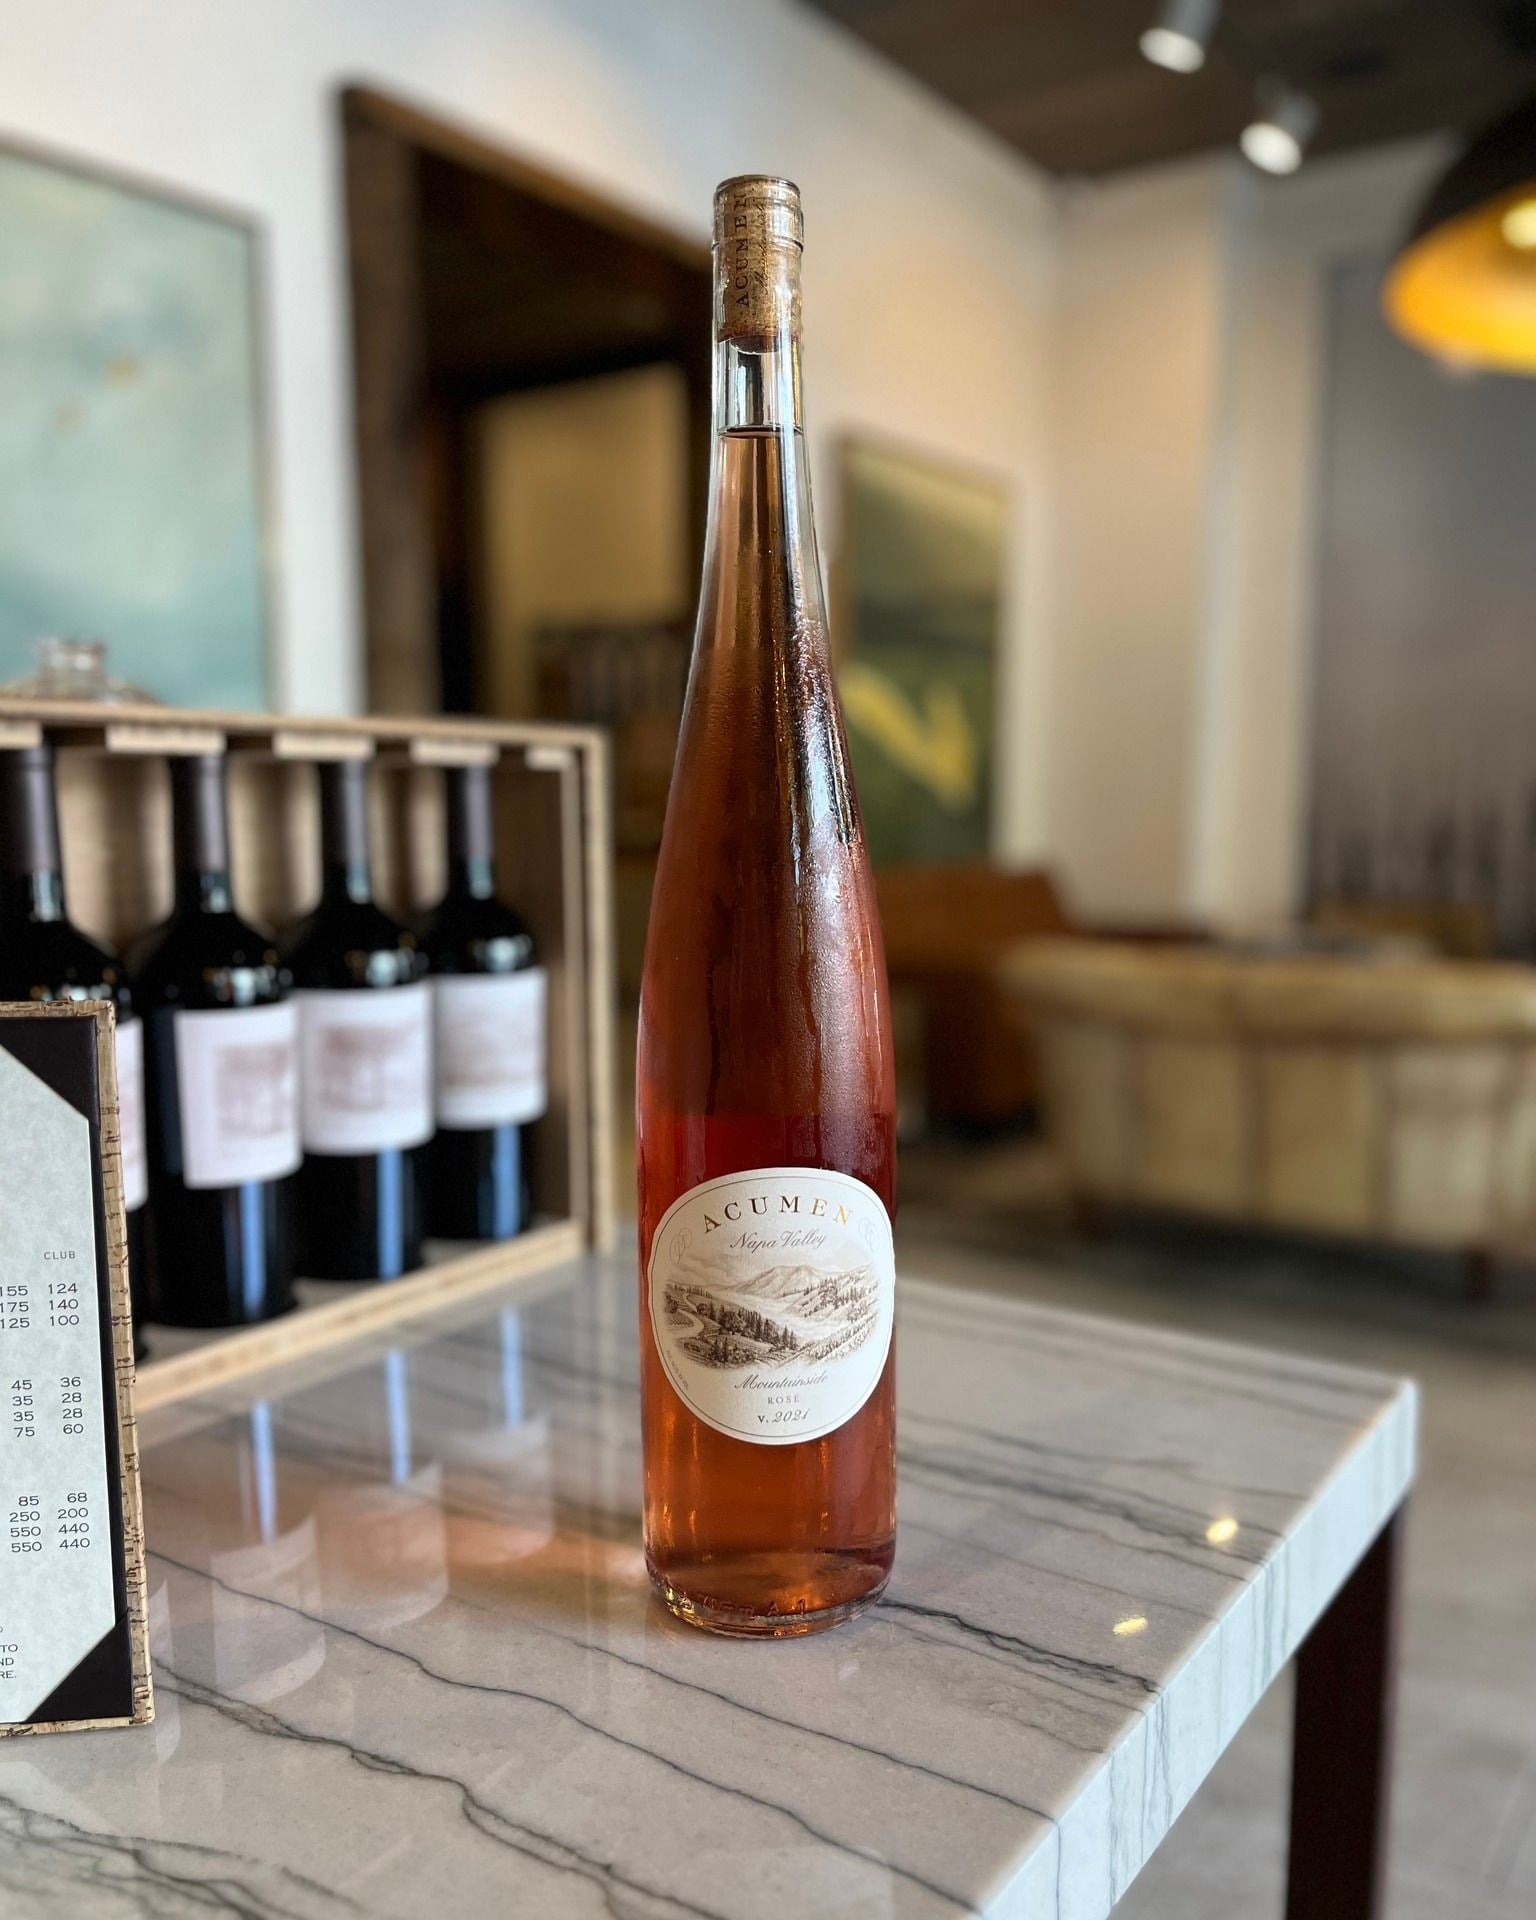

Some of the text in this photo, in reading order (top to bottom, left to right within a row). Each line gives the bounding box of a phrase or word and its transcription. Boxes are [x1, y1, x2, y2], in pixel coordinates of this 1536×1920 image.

[735, 191, 750, 308] ACUMEN
[703, 1195, 853, 1234] ACUMEN
[730, 1227, 828, 1254] Napa Valley
[43, 1250, 76, 1260] CLUB
[0, 1283, 78, 1297] 155 124
[0, 1298, 79, 1313] 175 140
[0, 1314, 80, 1329] 125 100
[11, 1376, 82, 1390] 45 36
[734, 1370, 828, 1391] Mountainside
[12, 1392, 82, 1407] 35 28
[13, 1408, 83, 1422] 35 28
[14, 1423, 84, 1438] 75 60
[18, 1492, 88, 1506] 85 68
[9, 1507, 89, 1523] 250 200
[10, 1522, 90, 1538] 550 440
[11, 1537, 91, 1553] 550 440
[0, 1643, 18, 1653] TO
